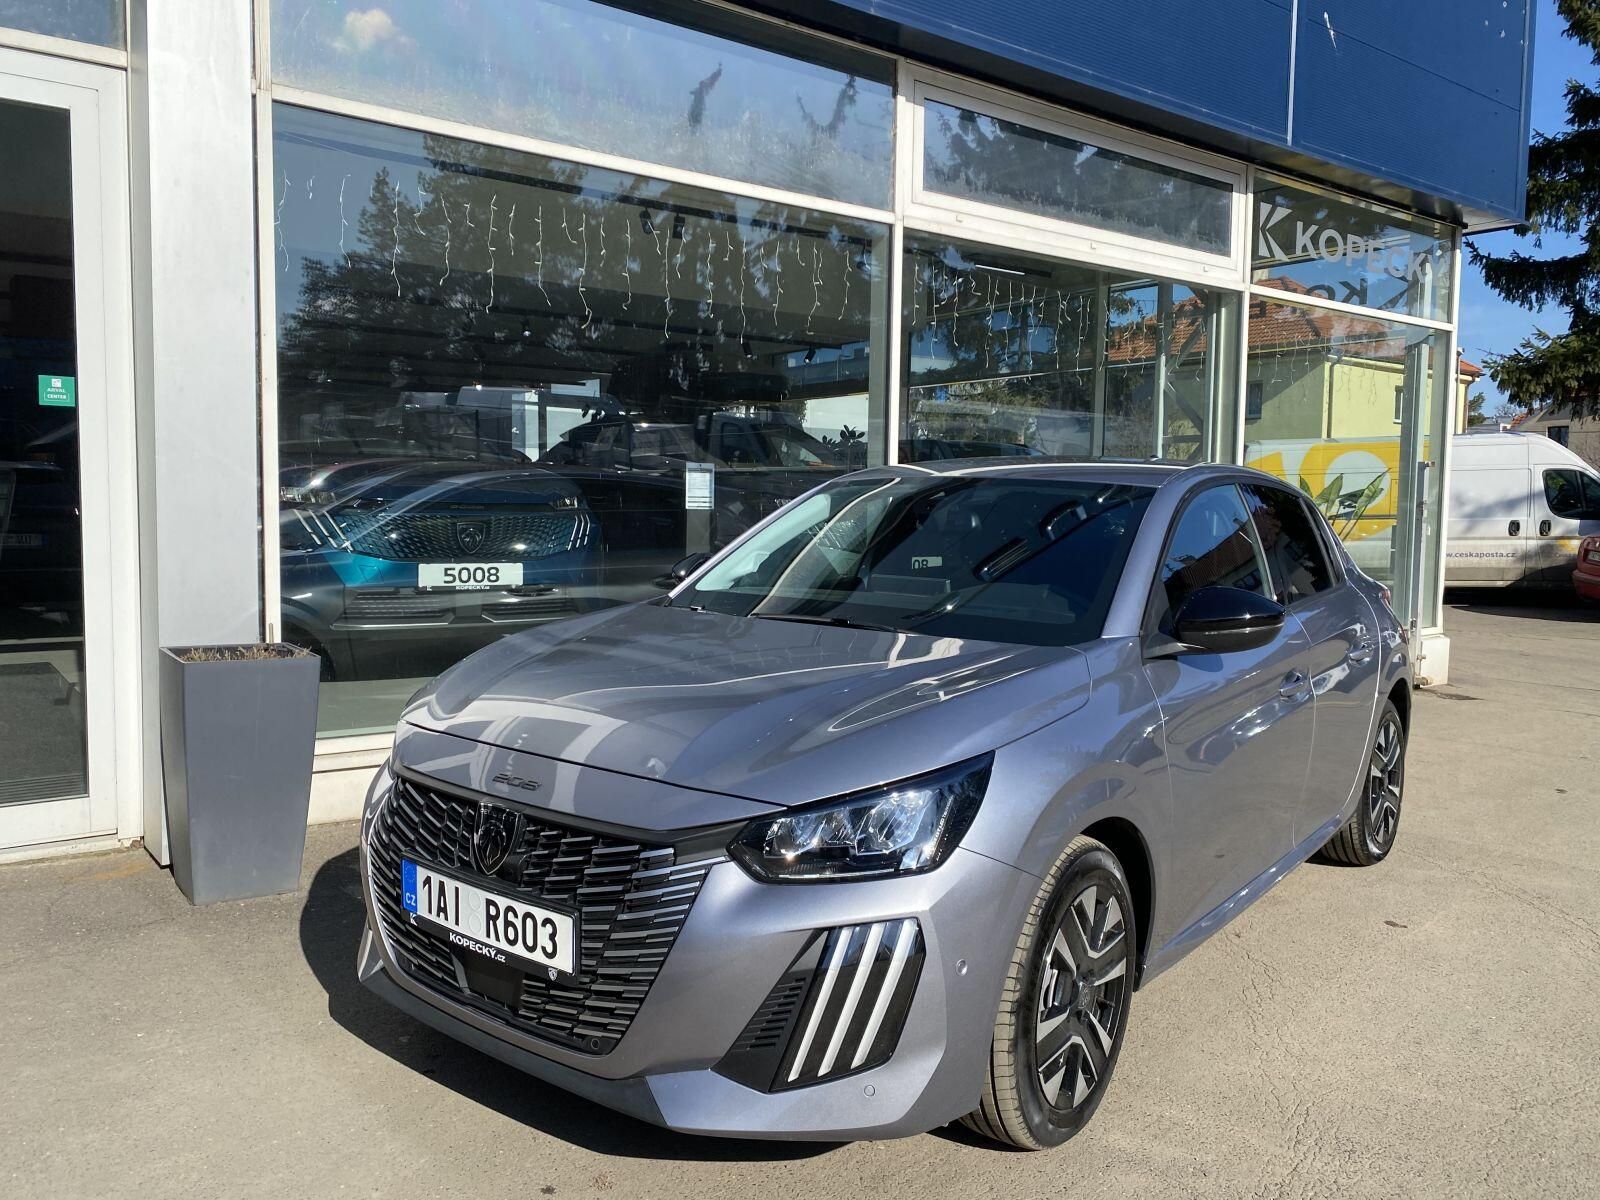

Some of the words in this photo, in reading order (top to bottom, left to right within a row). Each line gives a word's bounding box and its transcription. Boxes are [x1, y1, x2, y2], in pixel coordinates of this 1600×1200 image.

[443, 566, 500, 584] 5008
[492, 773, 542, 791] 208
[405, 892, 416, 907] CZ
[422, 875, 460, 927] 1AI
[485, 897, 558, 960] R603
[449, 932, 506, 963] KOPECKÝ.cz
